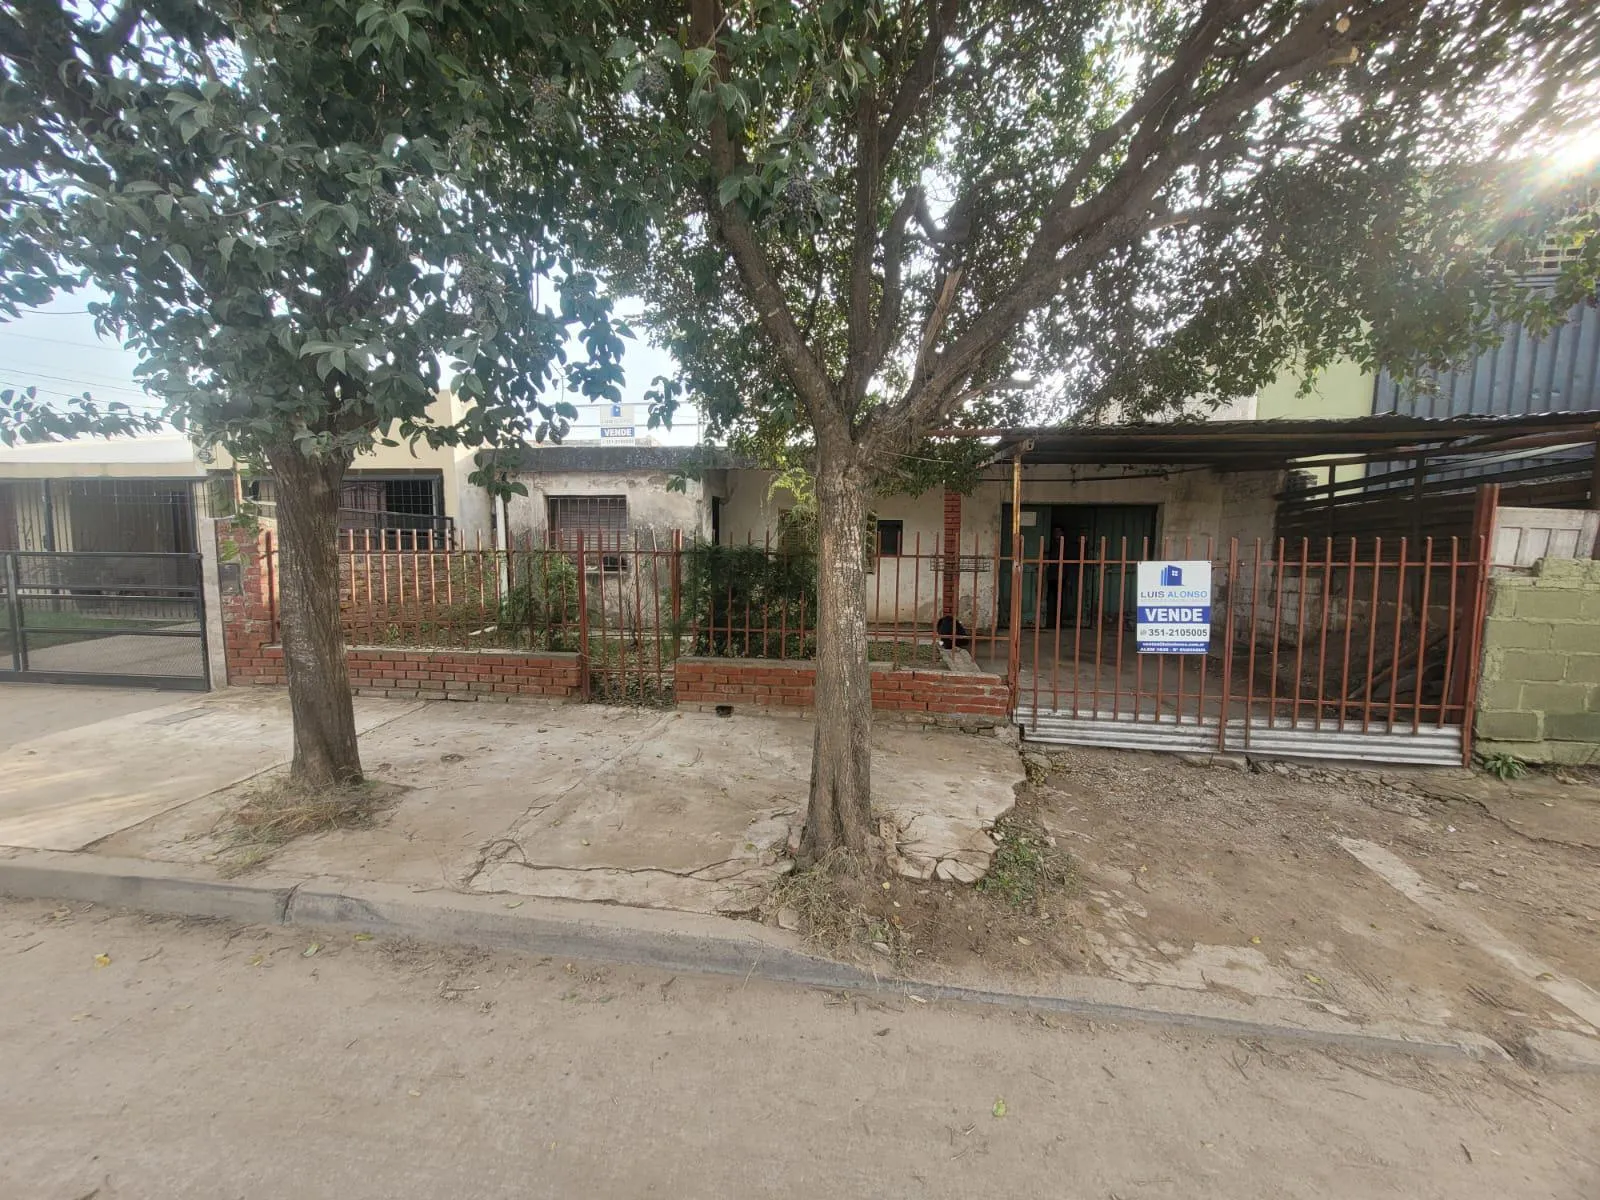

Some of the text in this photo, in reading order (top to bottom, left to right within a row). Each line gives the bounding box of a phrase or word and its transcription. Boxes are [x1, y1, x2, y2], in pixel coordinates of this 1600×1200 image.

[604, 428, 632, 436] VENDE
[1145, 608, 1203, 622] VENDE
[1148, 628, 1208, 637] 351-2105005
